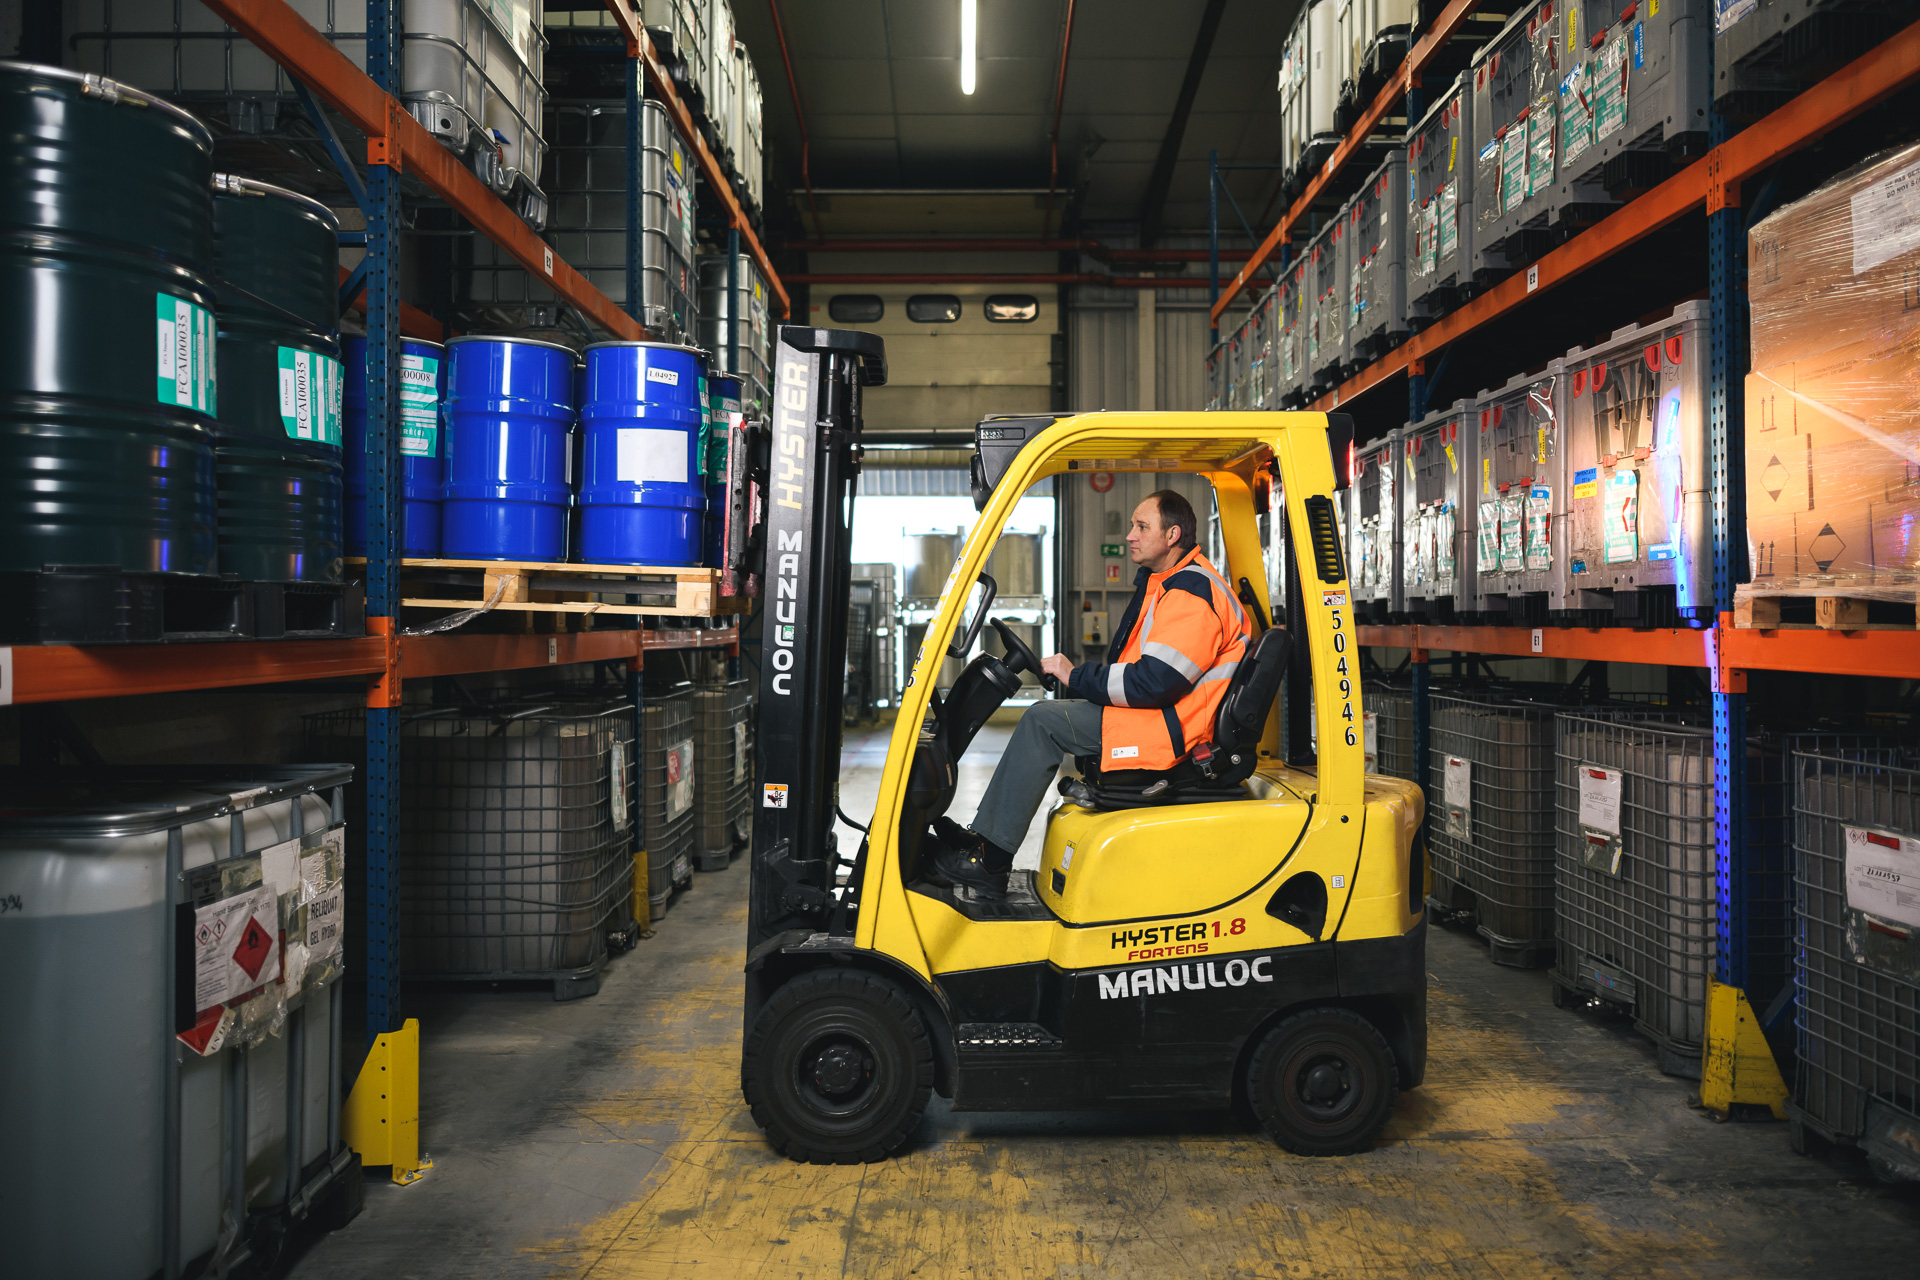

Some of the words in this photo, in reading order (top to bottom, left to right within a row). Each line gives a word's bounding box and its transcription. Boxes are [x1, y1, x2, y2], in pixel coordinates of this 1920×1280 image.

[1886, 190, 1896, 198] DO
[1896, 183, 1909, 194] NOT
[546, 255, 551, 269] E2
[1530, 272, 1536, 285] E2
[649, 370, 677, 381] L04927
[297, 361, 308, 429] FCAI00035
[778, 361, 810, 510] HYSTER
[772, 529, 803, 695] MANULOC
[1534, 635, 1540, 646] E1
[1332, 608, 1358, 746] 504946
[212, 907, 227, 919] Hand
[251, 904, 259, 914] UN
[310, 895, 338, 920] RELIQUAT
[310, 929, 320, 946] GEL
[321, 923, 337, 942] HYDRO
[1111, 922, 1207, 950] HYSTER
[1211, 917, 1246, 938] 1.8
[1128, 942, 1209, 961] FORTENS
[1098, 955, 1274, 1000] MANULOC
[211, 1036, 220, 1051] UN
